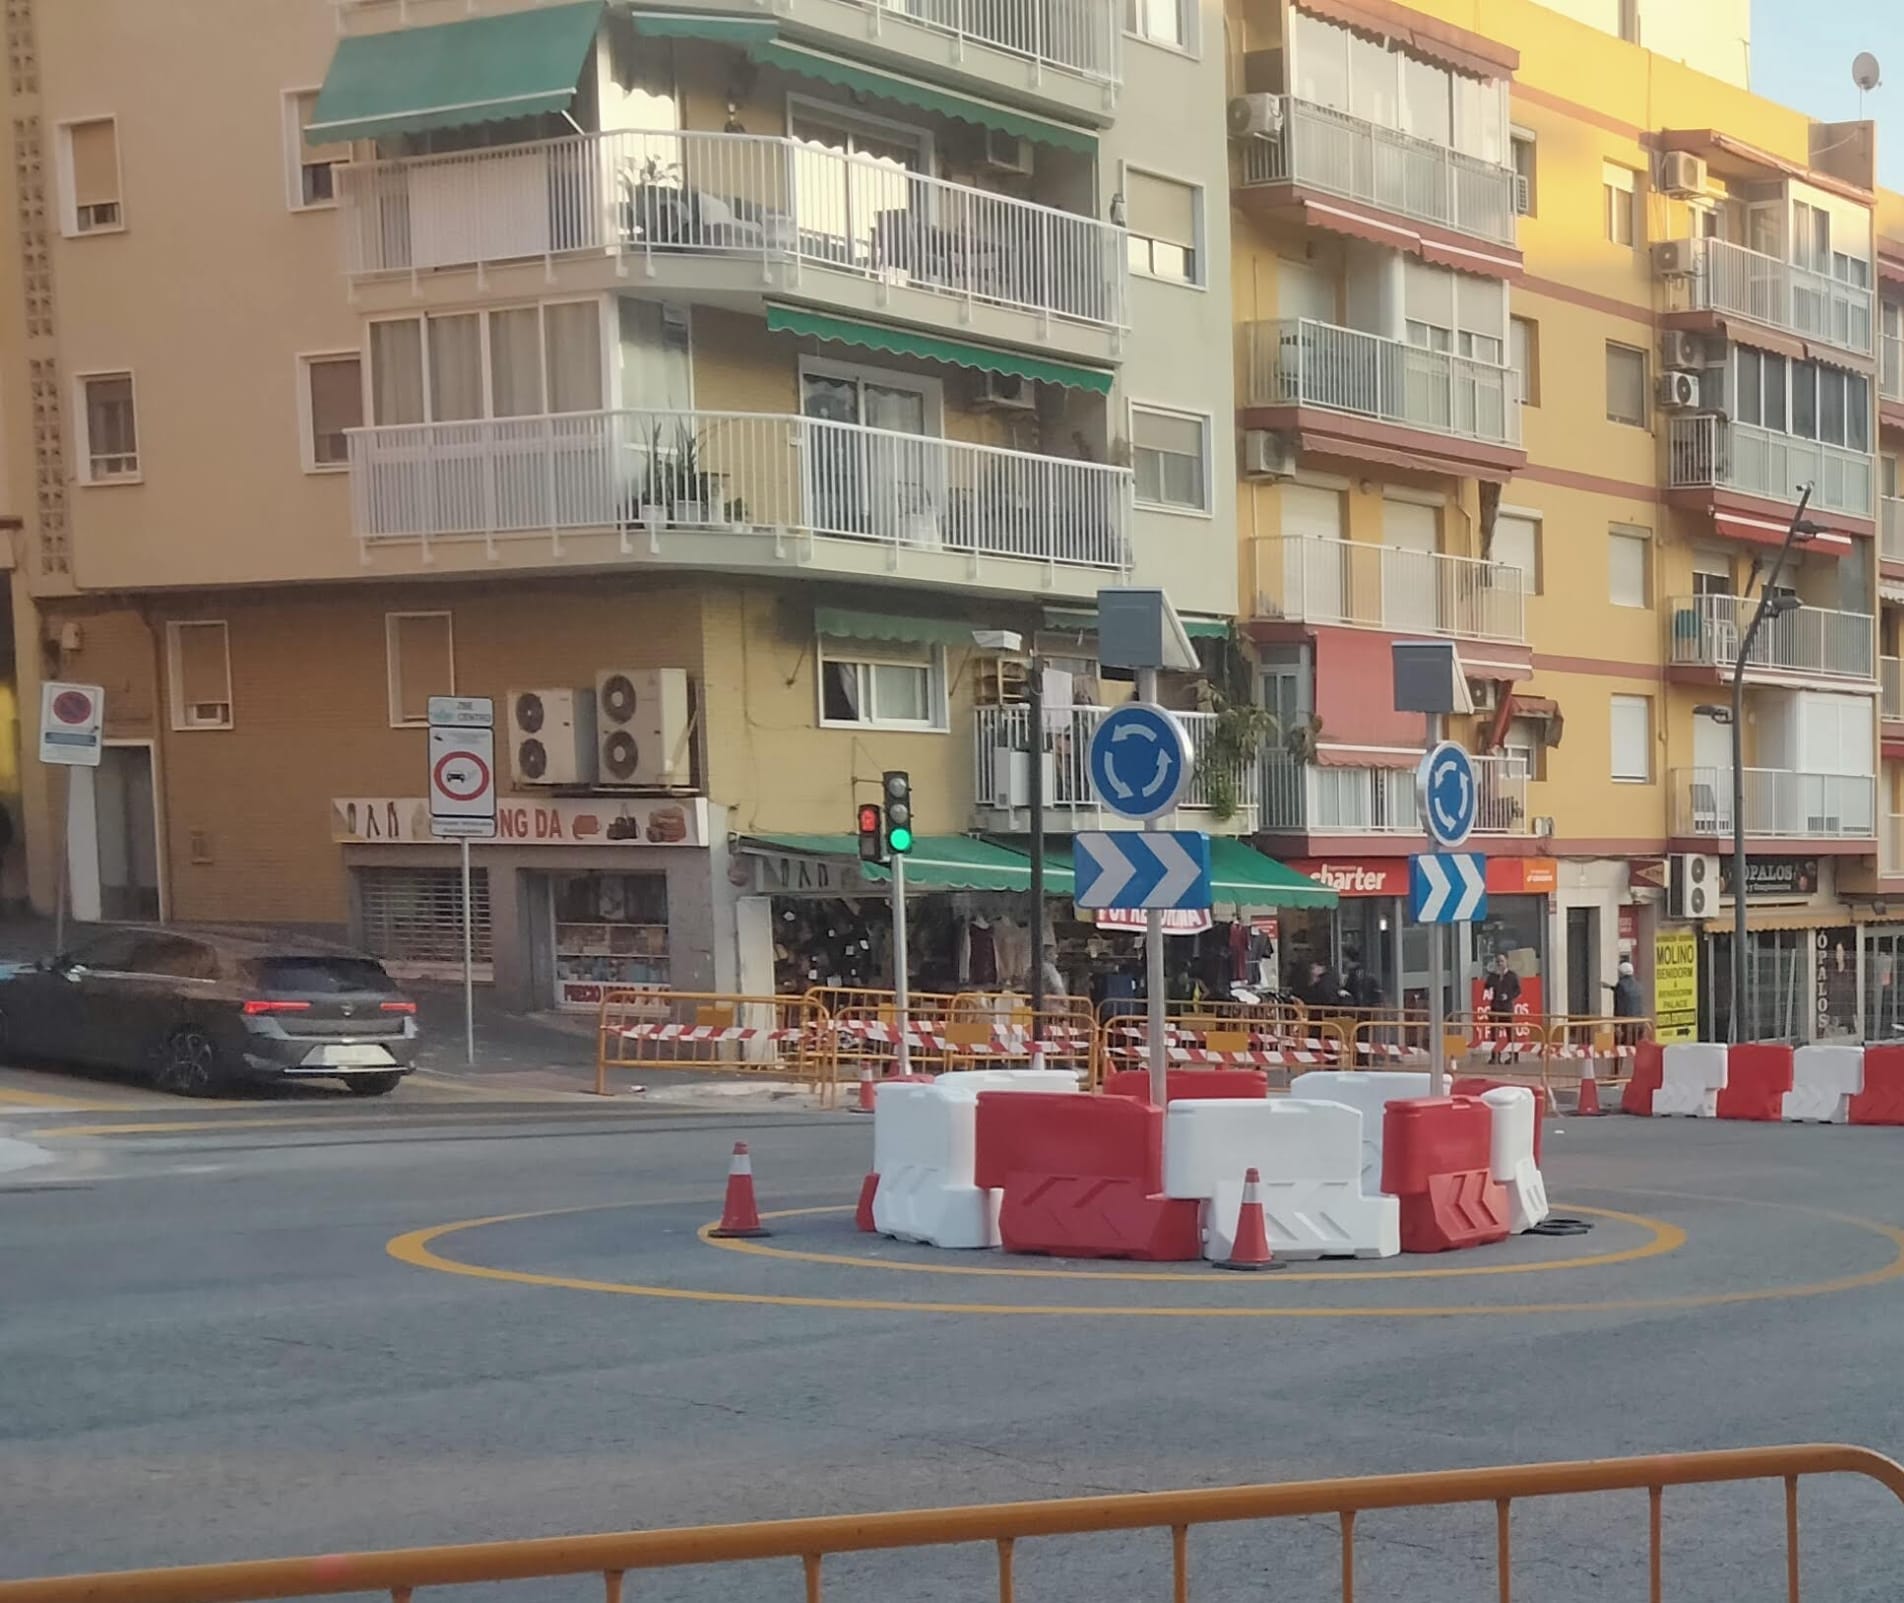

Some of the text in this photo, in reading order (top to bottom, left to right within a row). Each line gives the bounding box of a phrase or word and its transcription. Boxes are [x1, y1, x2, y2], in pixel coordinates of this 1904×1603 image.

[499, 809, 562, 838] NG DA
[1656, 944, 1694, 966] MOLINO
[1656, 966, 1693, 980] BENIDORM
[1662, 999, 1688, 1009] PALACE
